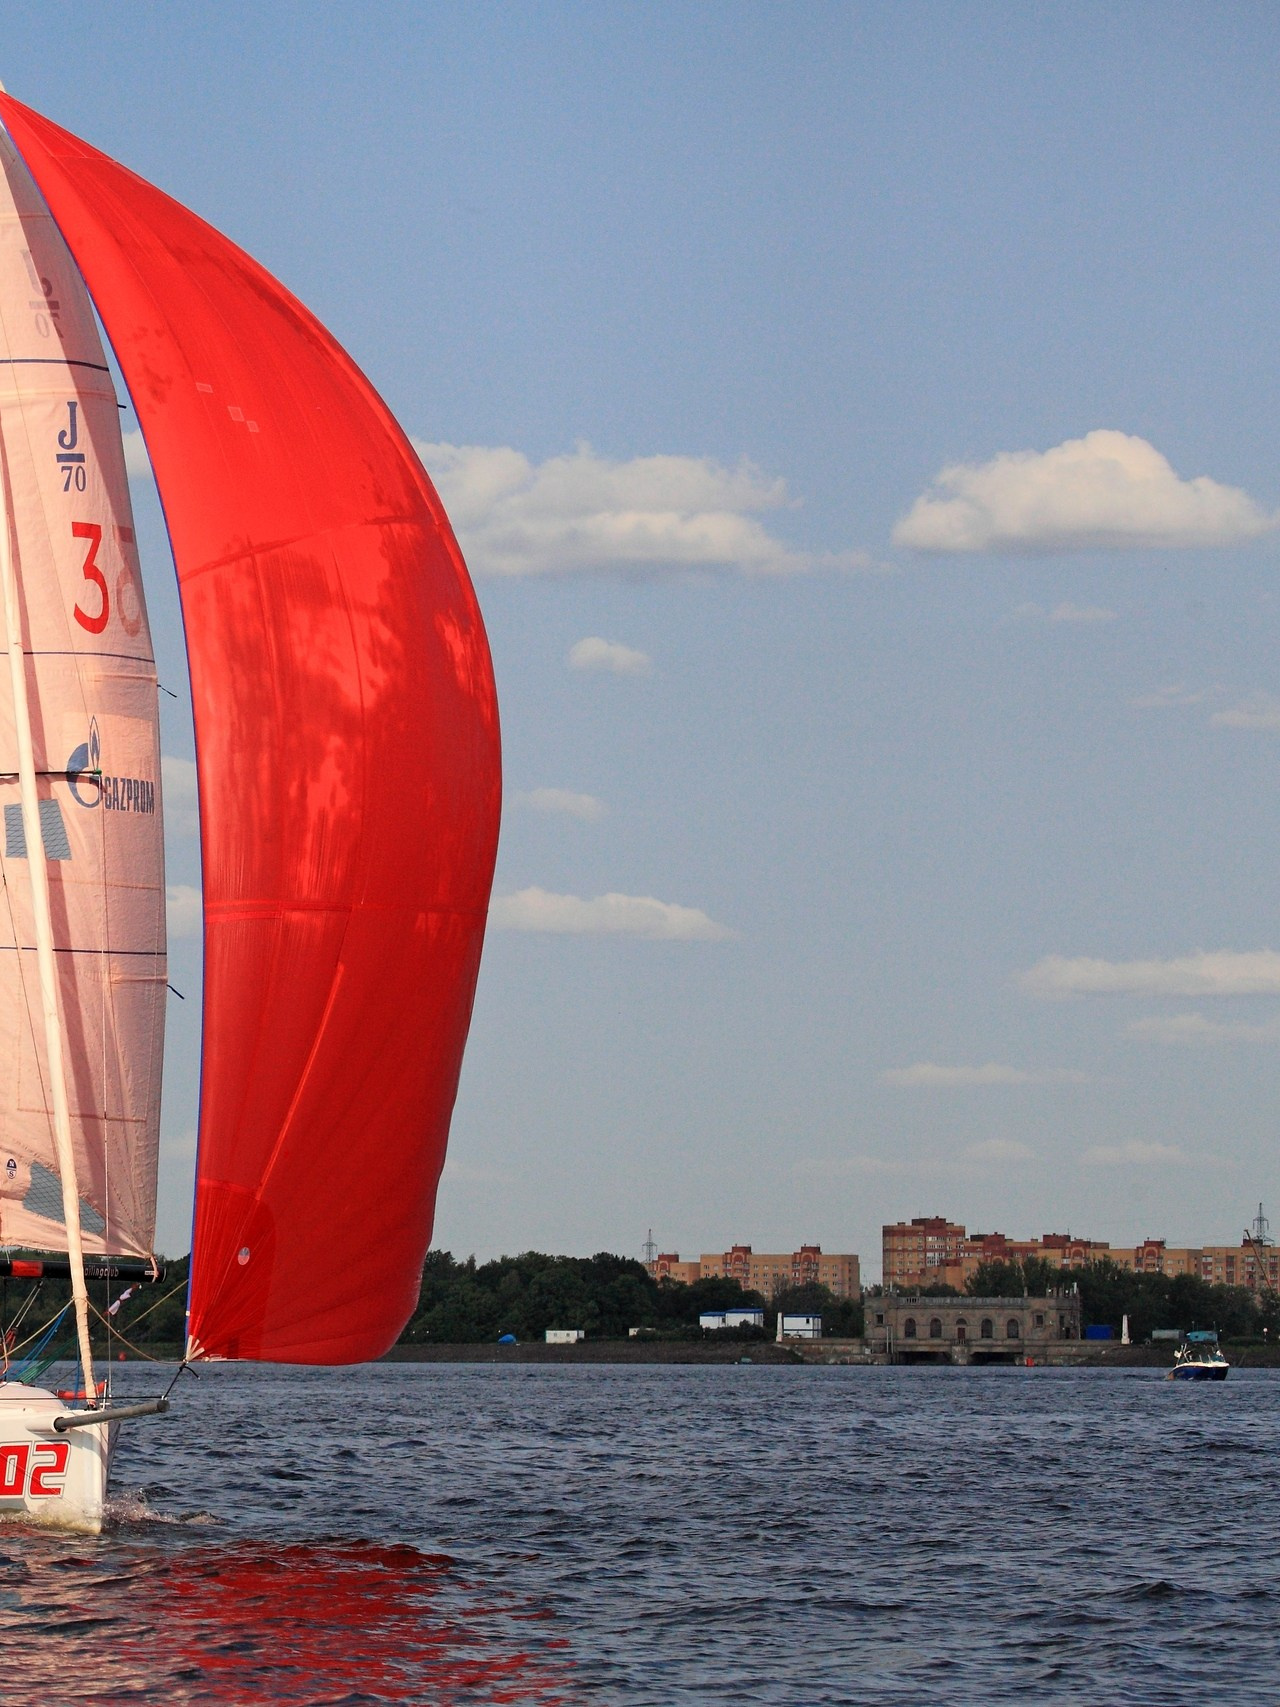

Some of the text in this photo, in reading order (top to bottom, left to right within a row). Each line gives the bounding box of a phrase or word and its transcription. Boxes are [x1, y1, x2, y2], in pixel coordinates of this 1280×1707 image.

[58, 401, 78, 450] J
[60, 465, 87, 492] 70
[71, 521, 110, 635] 3
[104, 776, 155, 815] GAZPROM
[84, 1264, 120, 1279] ailingclub
